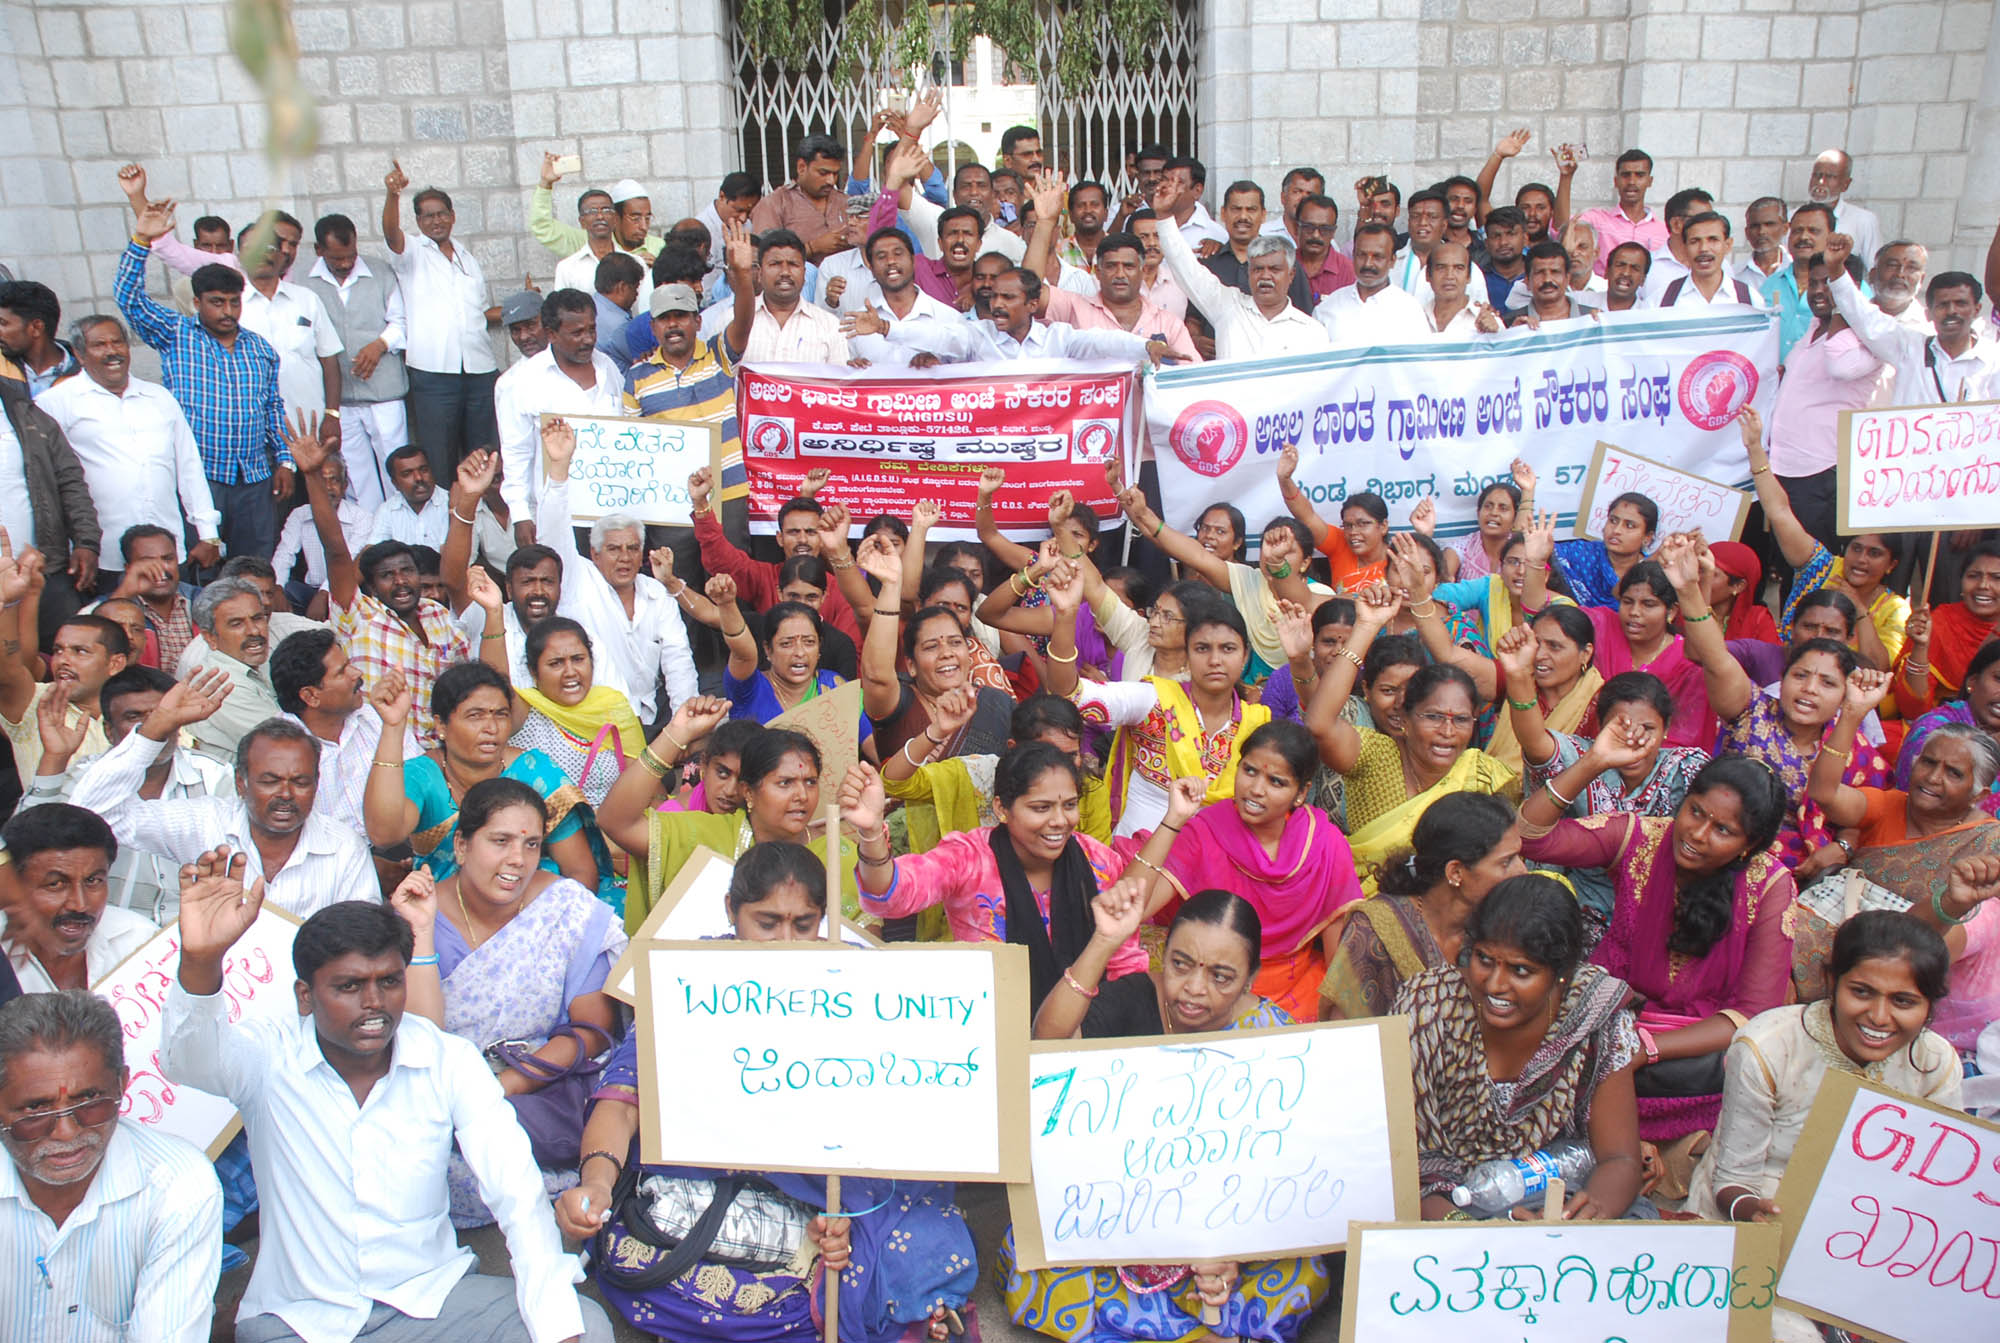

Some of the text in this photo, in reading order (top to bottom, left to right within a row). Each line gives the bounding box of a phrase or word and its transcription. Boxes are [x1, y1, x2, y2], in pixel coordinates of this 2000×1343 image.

[750, 381, 1121, 416] ಅಖಿಲ ಭಾರತ ಗ್ರಾಮೀಣ ಅಂಚೆ ನೌಕರರ ಸಂಘ
[1255, 410, 1304, 455] ಅಖಿಲ
[1313, 385, 1376, 454] ಭಾರತ
[1388, 394, 1466, 461] ಗ್ರಾಮೀಣ
[1476, 376, 1522, 435] ಅಂಚೆ
[1534, 366, 1609, 429] ನೌಕರರ
[1620, 361, 1671, 426] ಸಂಘ
[898, 411, 974, 423] (AIGDSU)
[1708, 414, 1729, 427] GDS
[615, 426, 685, 453] ವೇತನ
[880, 461, 910, 473] ನಮ್ಮ
[1198, 461, 1220, 473] GDS
[590, 480, 659, 508] ಜಾರಿಗೆ
[1645, 476, 1729, 517] ವೇತನ
[733, 1046, 980, 1095] ಜಿಂದಾಬಾದ್
[1032, 1038, 1312, 1136] 7ನೇ ವೇತನ
[1124, 1118, 1292, 1179] ಆಯೋಗ
